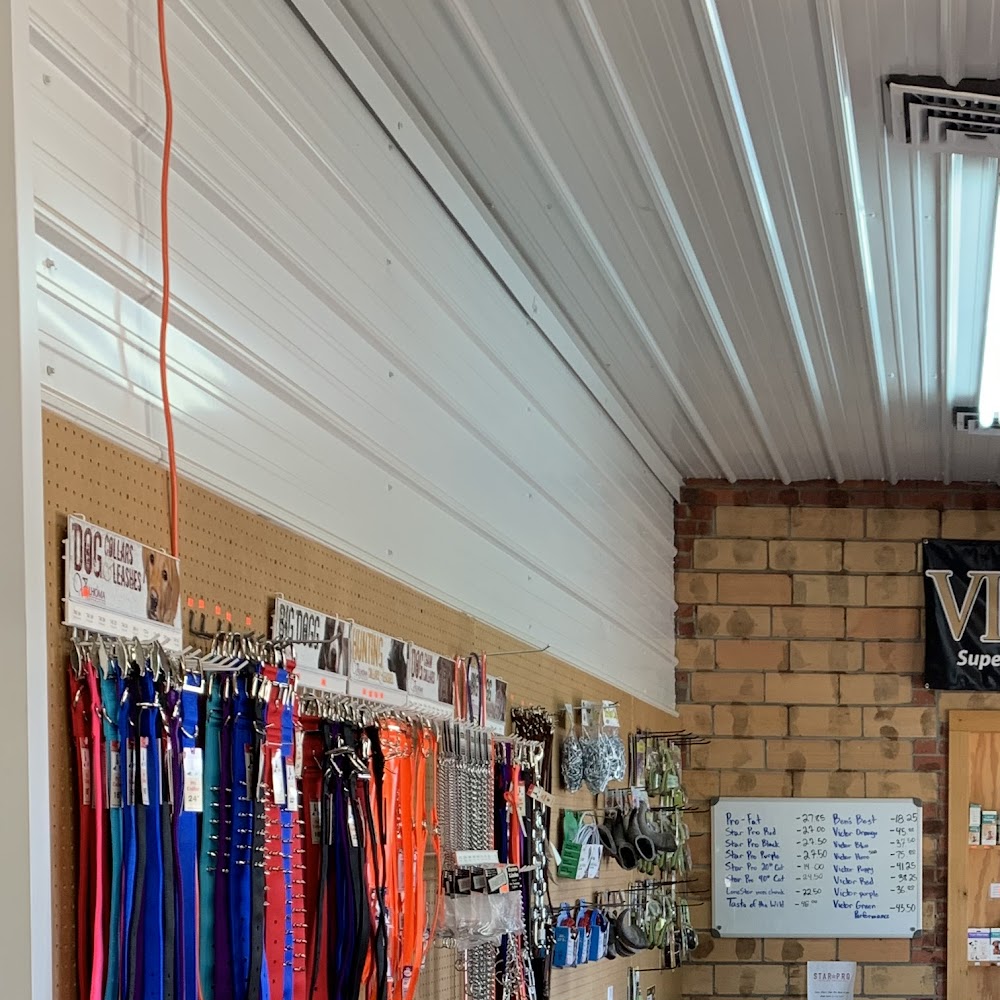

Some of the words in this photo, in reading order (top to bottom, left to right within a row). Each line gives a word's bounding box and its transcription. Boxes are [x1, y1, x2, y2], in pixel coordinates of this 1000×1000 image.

[72, 523, 102, 578] DOG
[104, 534, 133, 565] COLLARS
[113, 562, 142, 592] LEASHES
[725, 827, 743, 836] Star
[747, 827, 760, 836] Pro
[833, 827, 853, 837] Victor
[725, 839, 743, 848] Star
[747, 838, 759, 848] Pro
[725, 849, 743, 860] Star
[746, 850, 757, 860] Pro
[725, 862, 743, 871] Star
[746, 862, 757, 871] Pro
[834, 865, 853, 873] Victor
[834, 876, 857, 885] Victor
[834, 888, 857, 896] Victor
[750, 899, 756, 908] of
[833, 900, 853, 909] Victor
